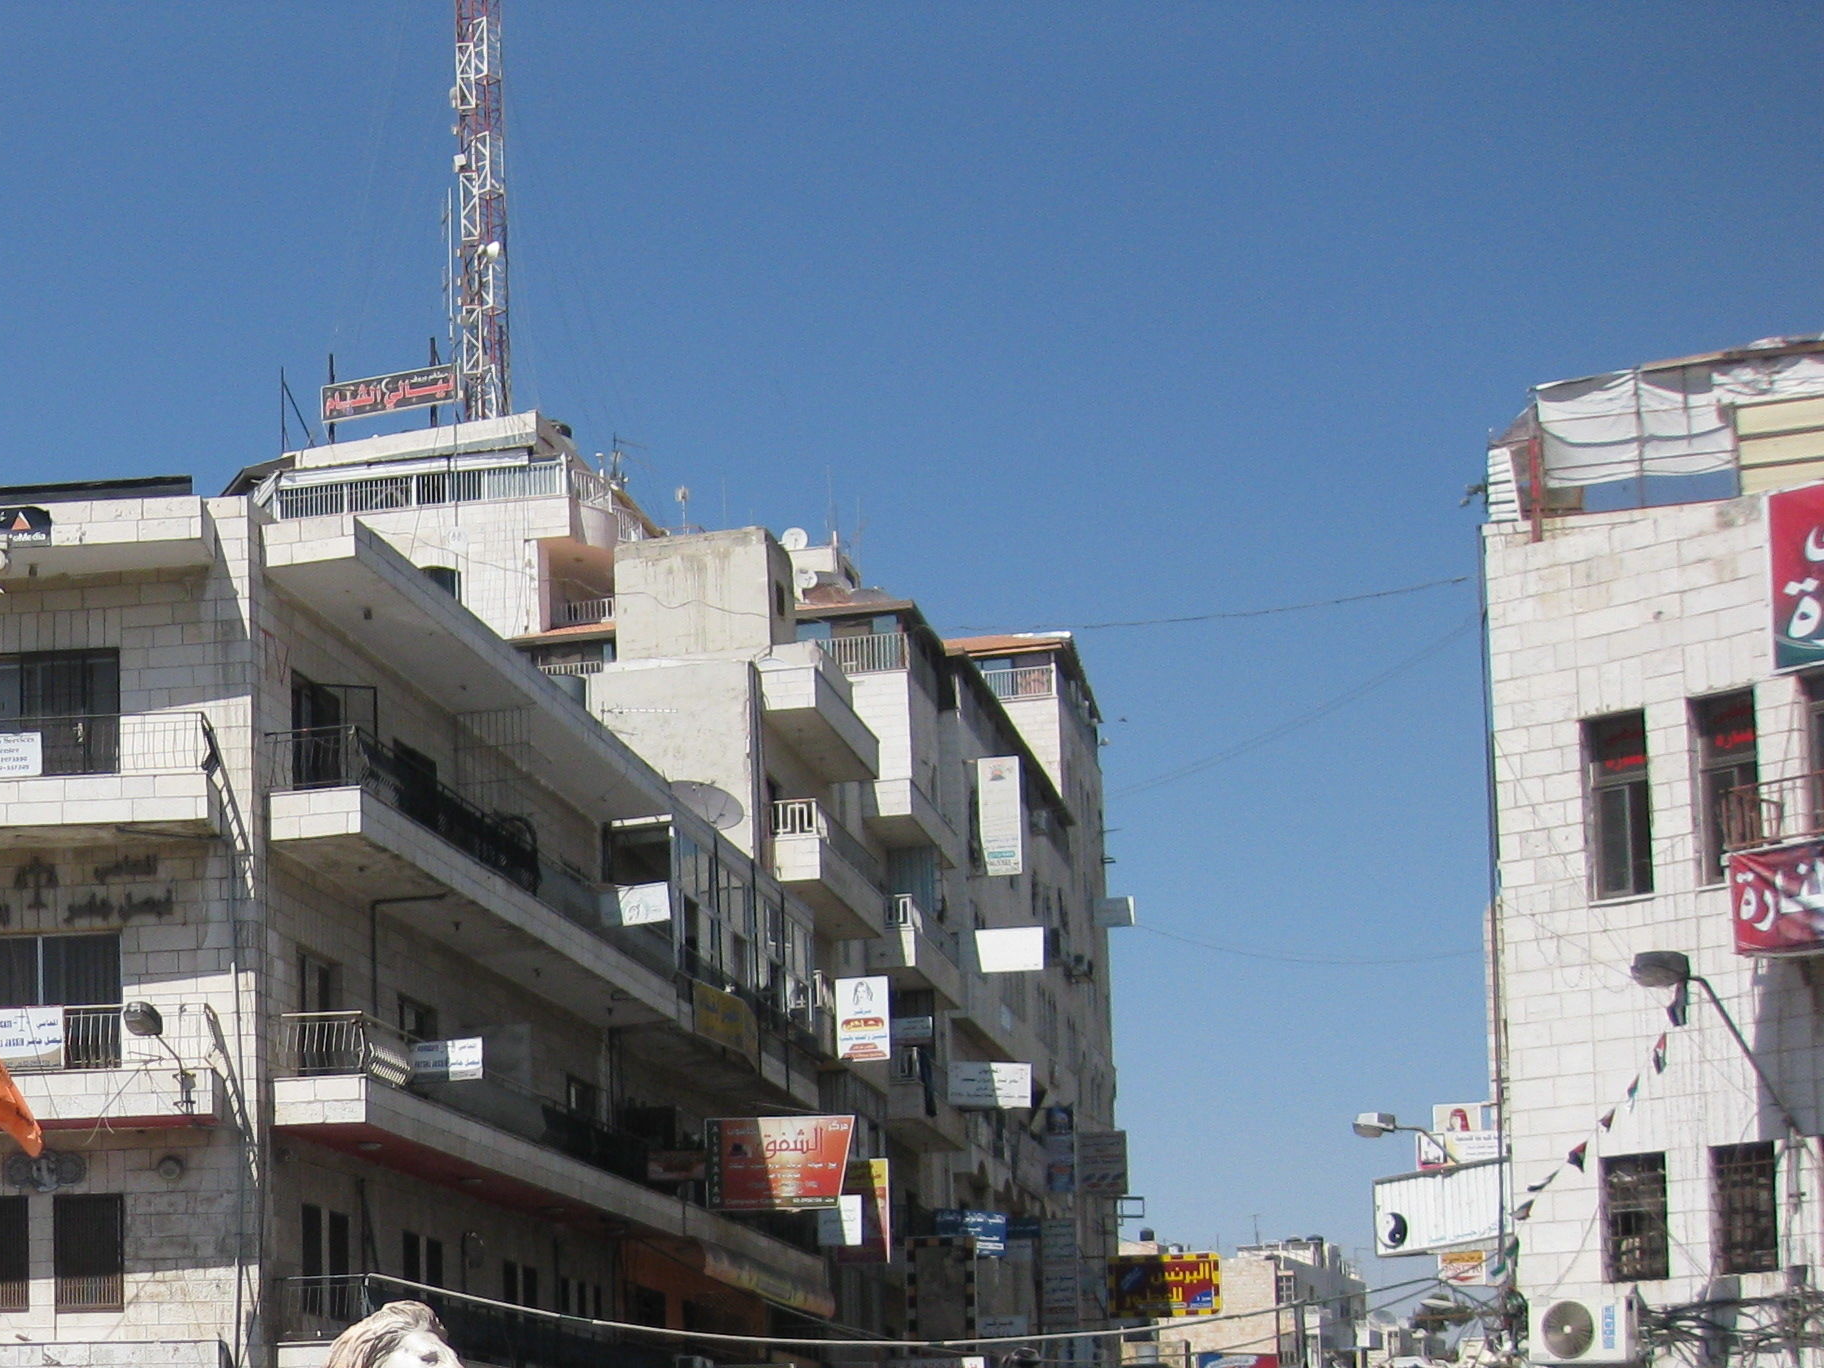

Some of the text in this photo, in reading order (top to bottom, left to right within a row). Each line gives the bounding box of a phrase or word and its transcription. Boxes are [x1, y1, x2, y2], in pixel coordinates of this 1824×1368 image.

[326, 373, 455, 416] ليالي الشام
[35, 1018, 59, 1029] المحامي
[828, 1119, 849, 1131] مركز
[762, 1127, 824, 1159] الشفق
